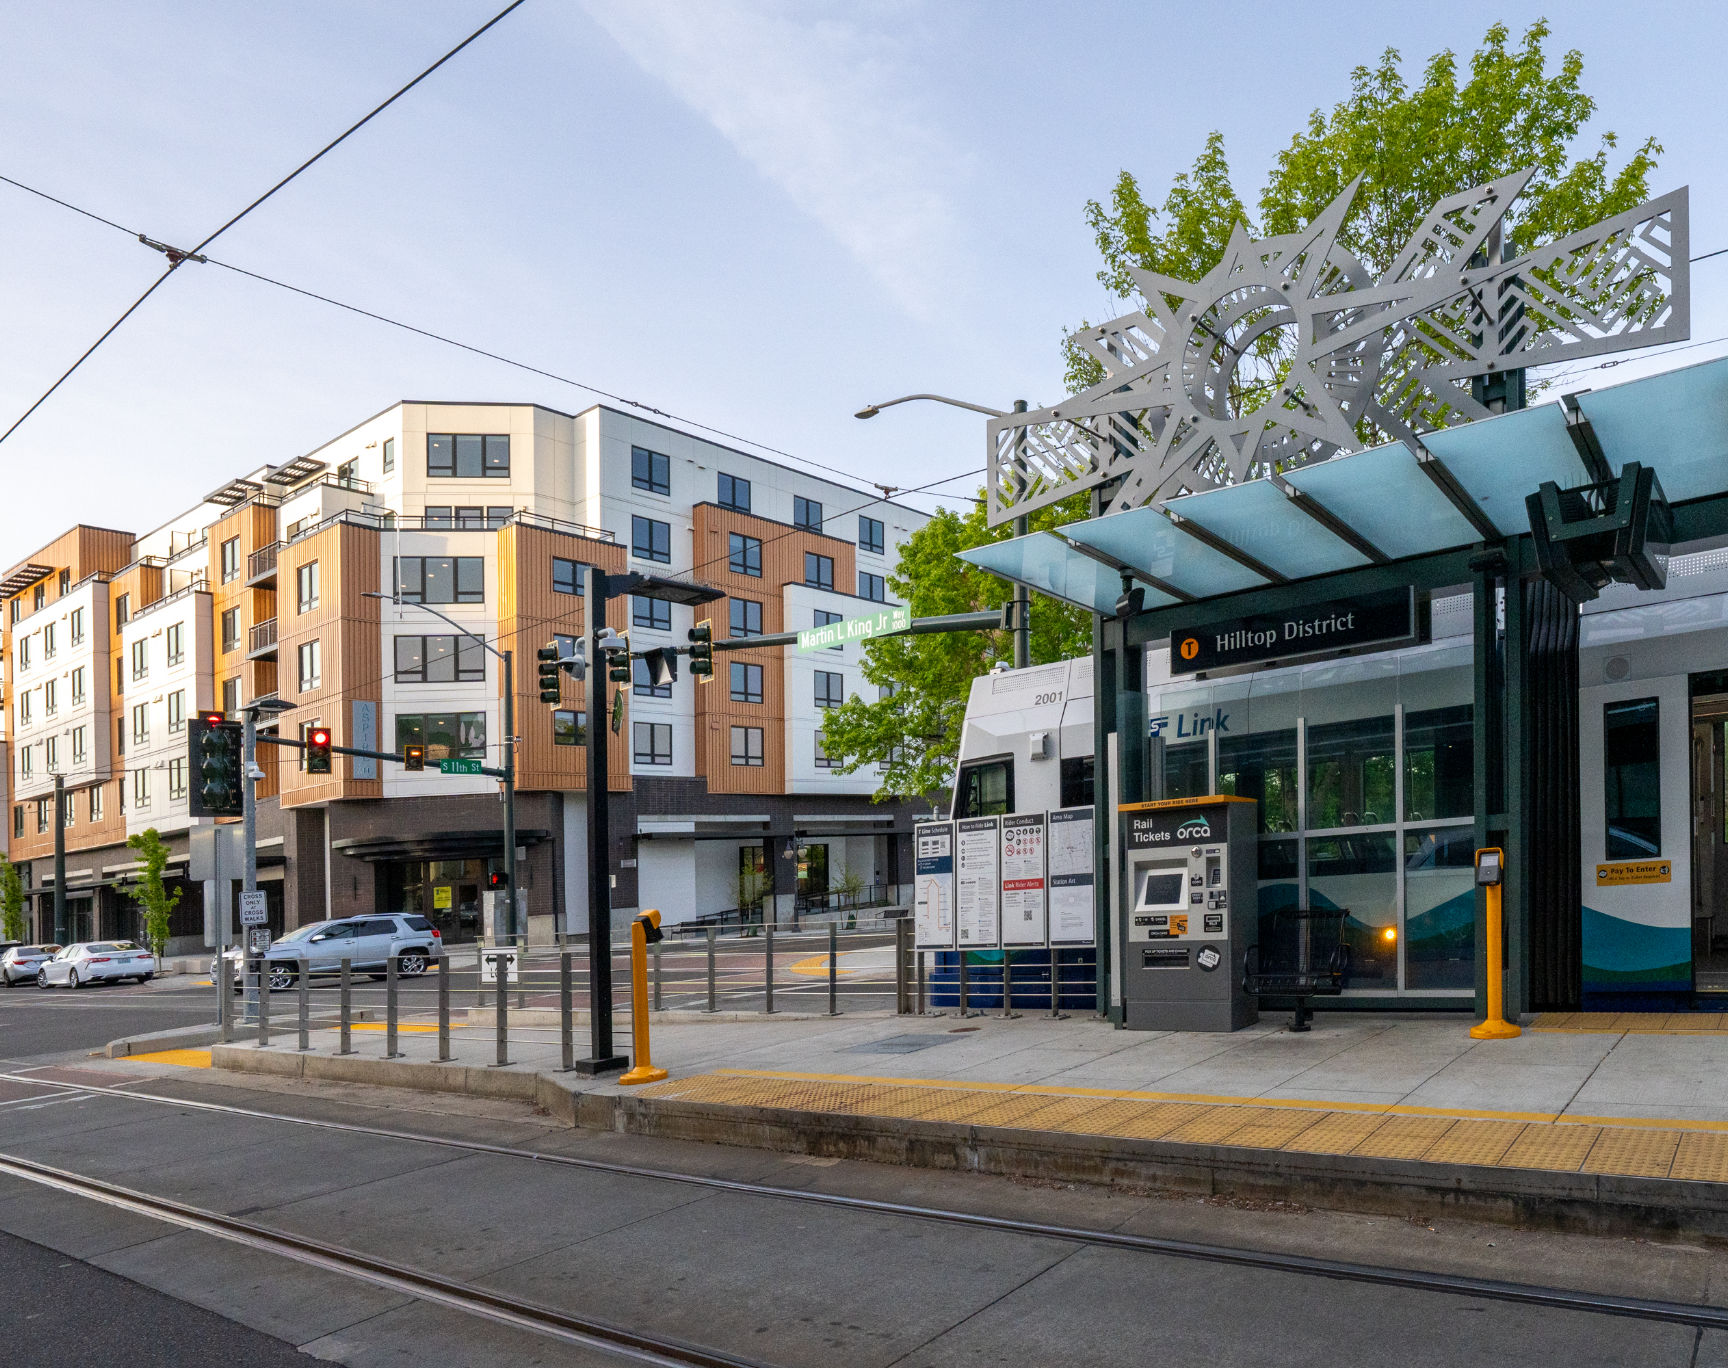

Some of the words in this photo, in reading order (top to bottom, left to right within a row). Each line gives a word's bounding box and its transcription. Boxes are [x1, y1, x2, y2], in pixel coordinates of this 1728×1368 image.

[892, 610, 905, 620] Way
[802, 627, 834, 649] Martin
[837, 623, 844, 640] L
[847, 619, 872, 638] King
[875, 613, 888, 631] Jr
[892, 619, 906, 631] 1000
[1216, 630, 1277, 652] Hilltop
[1284, 613, 1355, 641] District
[1034, 691, 1063, 706] 2001
[1177, 708, 1230, 739] Link
[442, 762, 449, 771] S
[451, 761, 468, 773] 11th
[471, 763, 480, 772] St
[1016, 817, 1034, 825] Conduct
[1133, 818, 1153, 830] Rail
[1133, 831, 1171, 843] Tickets
[1177, 826, 1211, 839] orca
[1610, 868, 1624, 876] Pay
[1027, 880, 1040, 888] Alerts
